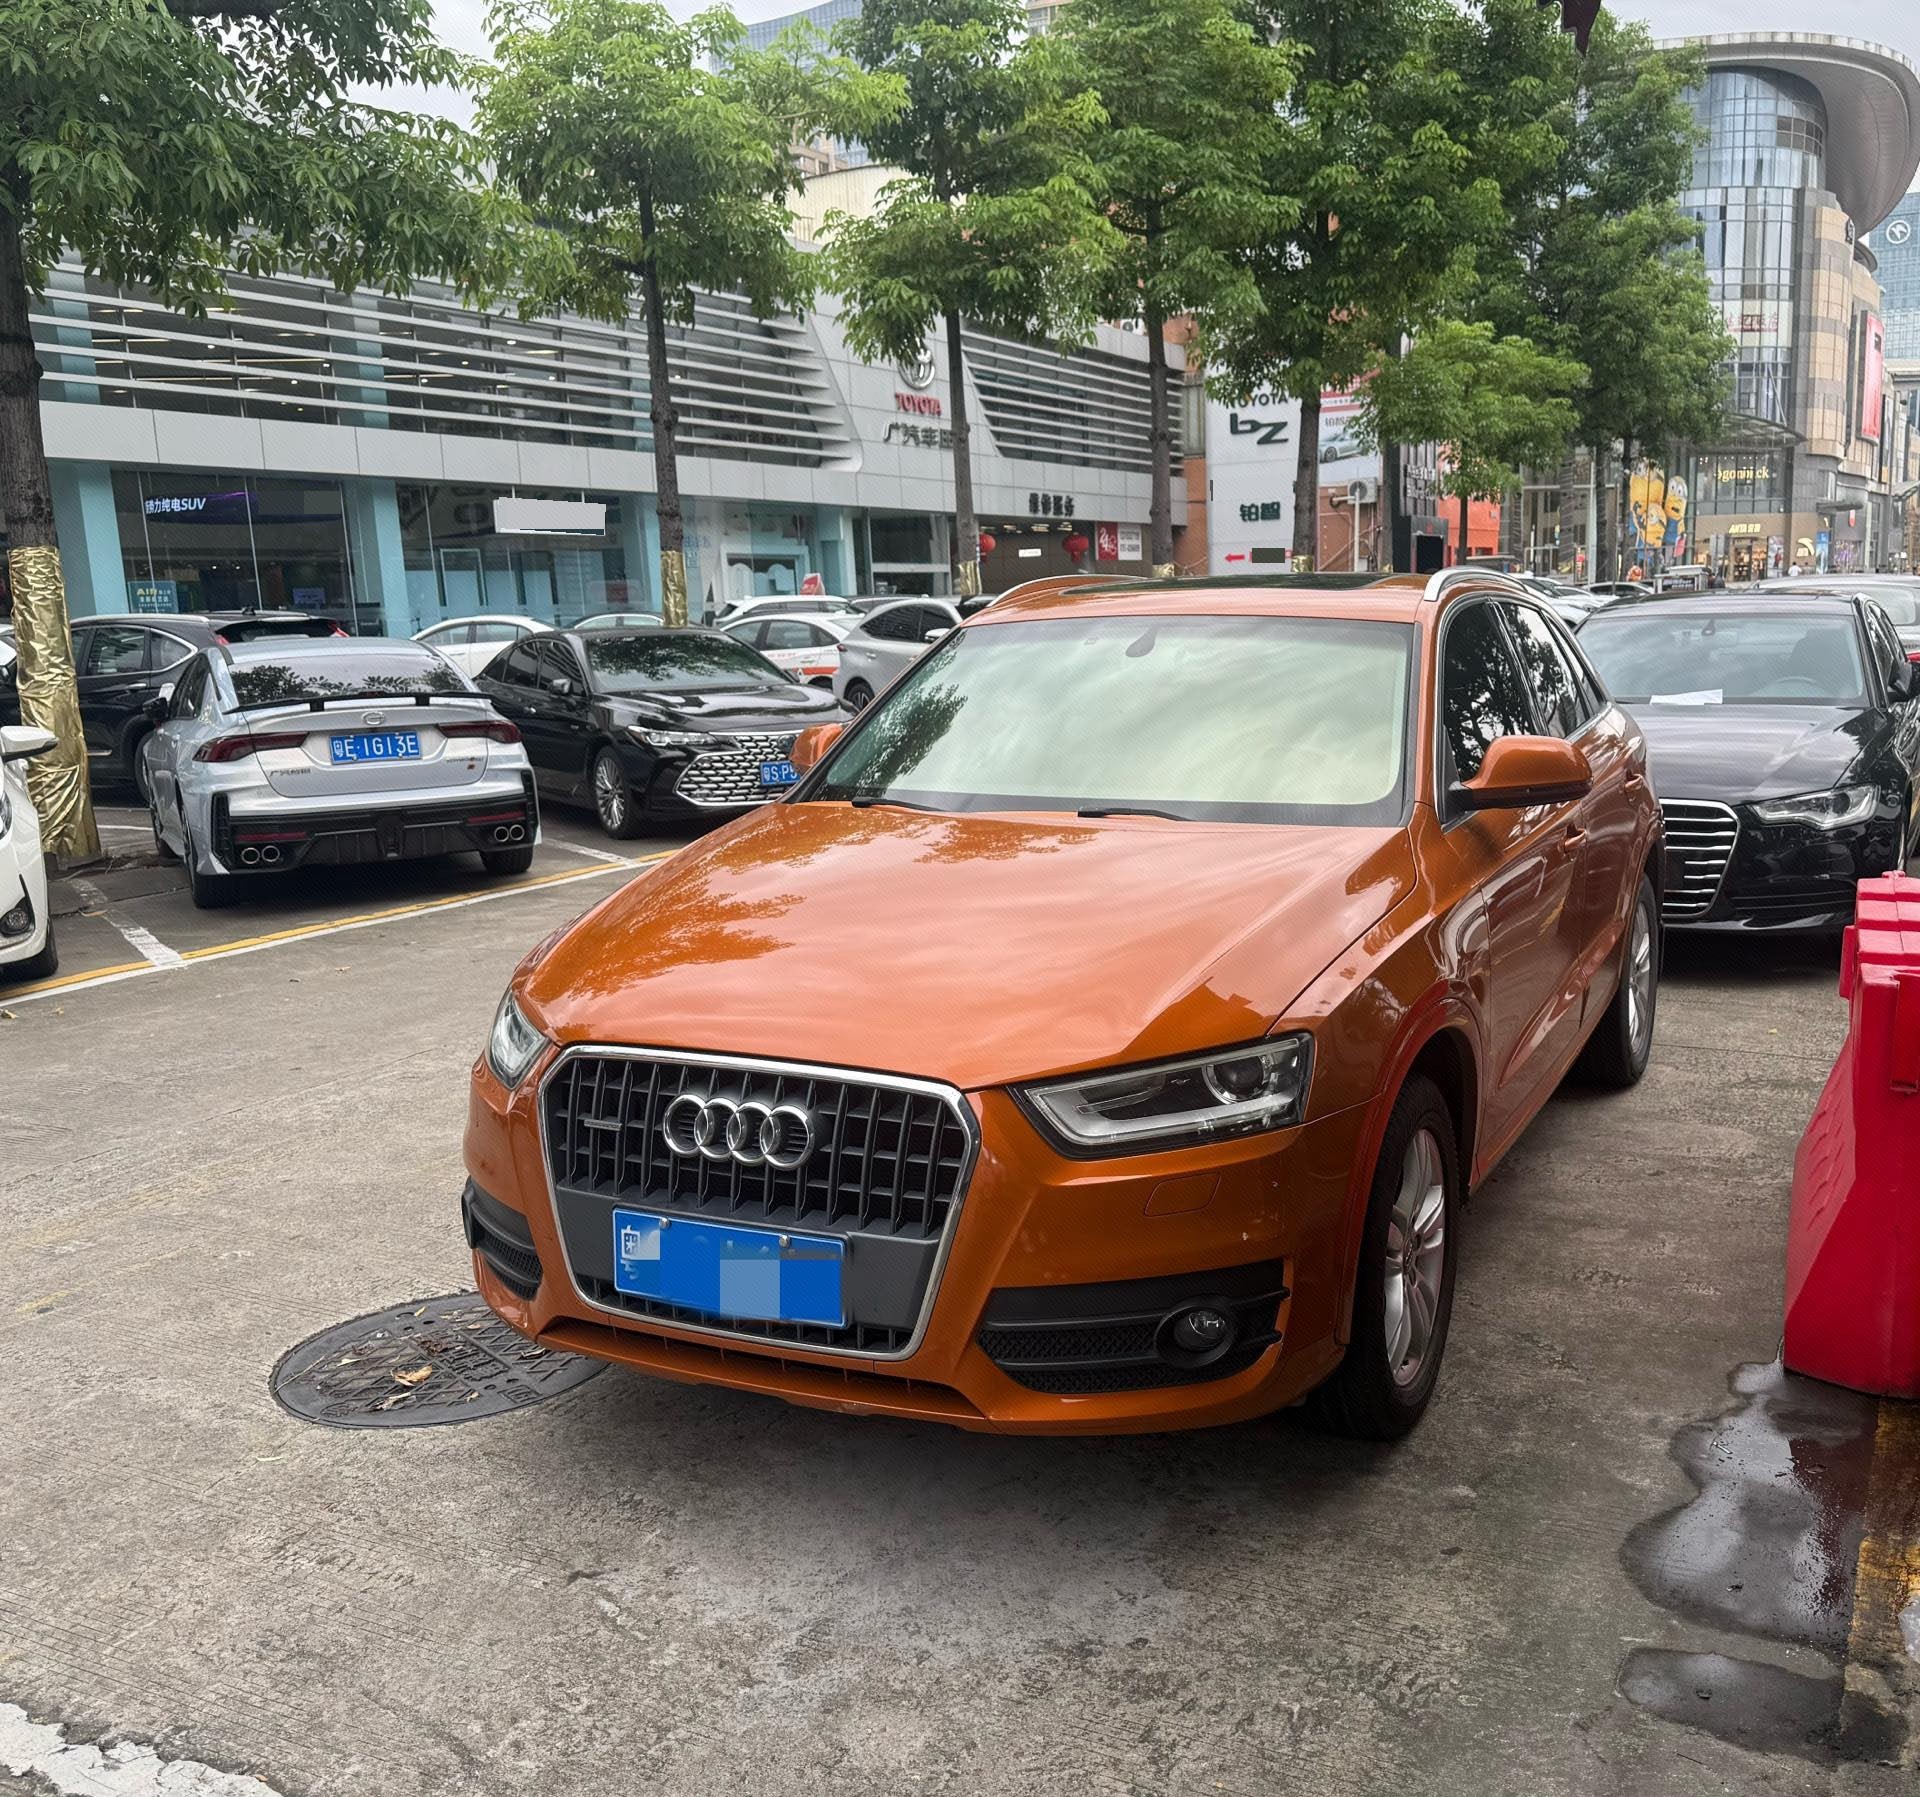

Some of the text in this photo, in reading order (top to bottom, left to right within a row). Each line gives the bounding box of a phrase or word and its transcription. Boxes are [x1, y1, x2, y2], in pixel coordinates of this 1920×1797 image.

[894, 392, 942, 416] TOYOTA
[1227, 393, 1288, 410] OYOTA
[883, 422, 953, 448] 广汽丰田
[1240, 502, 1280, 522] 铂智
